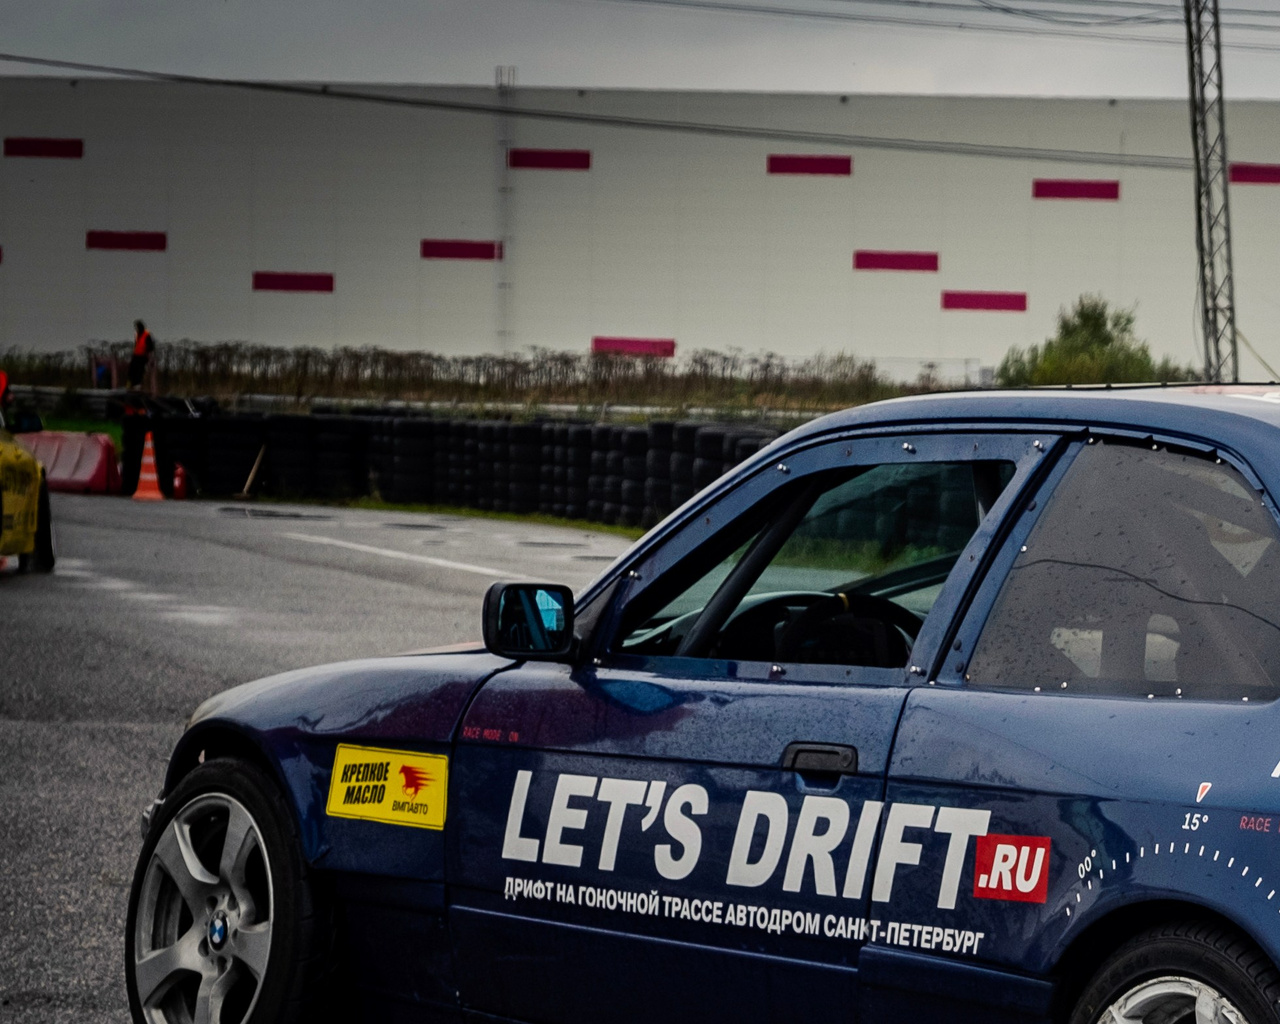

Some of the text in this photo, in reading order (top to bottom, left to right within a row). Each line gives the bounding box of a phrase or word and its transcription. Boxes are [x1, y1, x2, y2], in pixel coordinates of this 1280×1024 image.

[340, 762, 391, 783] КРЕПКОЕ
[342, 784, 387, 805] МАСЛО
[501, 769, 992, 910] LET'S DRIFT
[1239, 815, 1272, 833] RACE
[977, 843, 1046, 893] .RU
[504, 876, 985, 956] ДРИФТ НА ГОНОЧНОЙ ТРАССЕ АВТОДРОМ САНКТ-ПЕТЕРБУРГ
